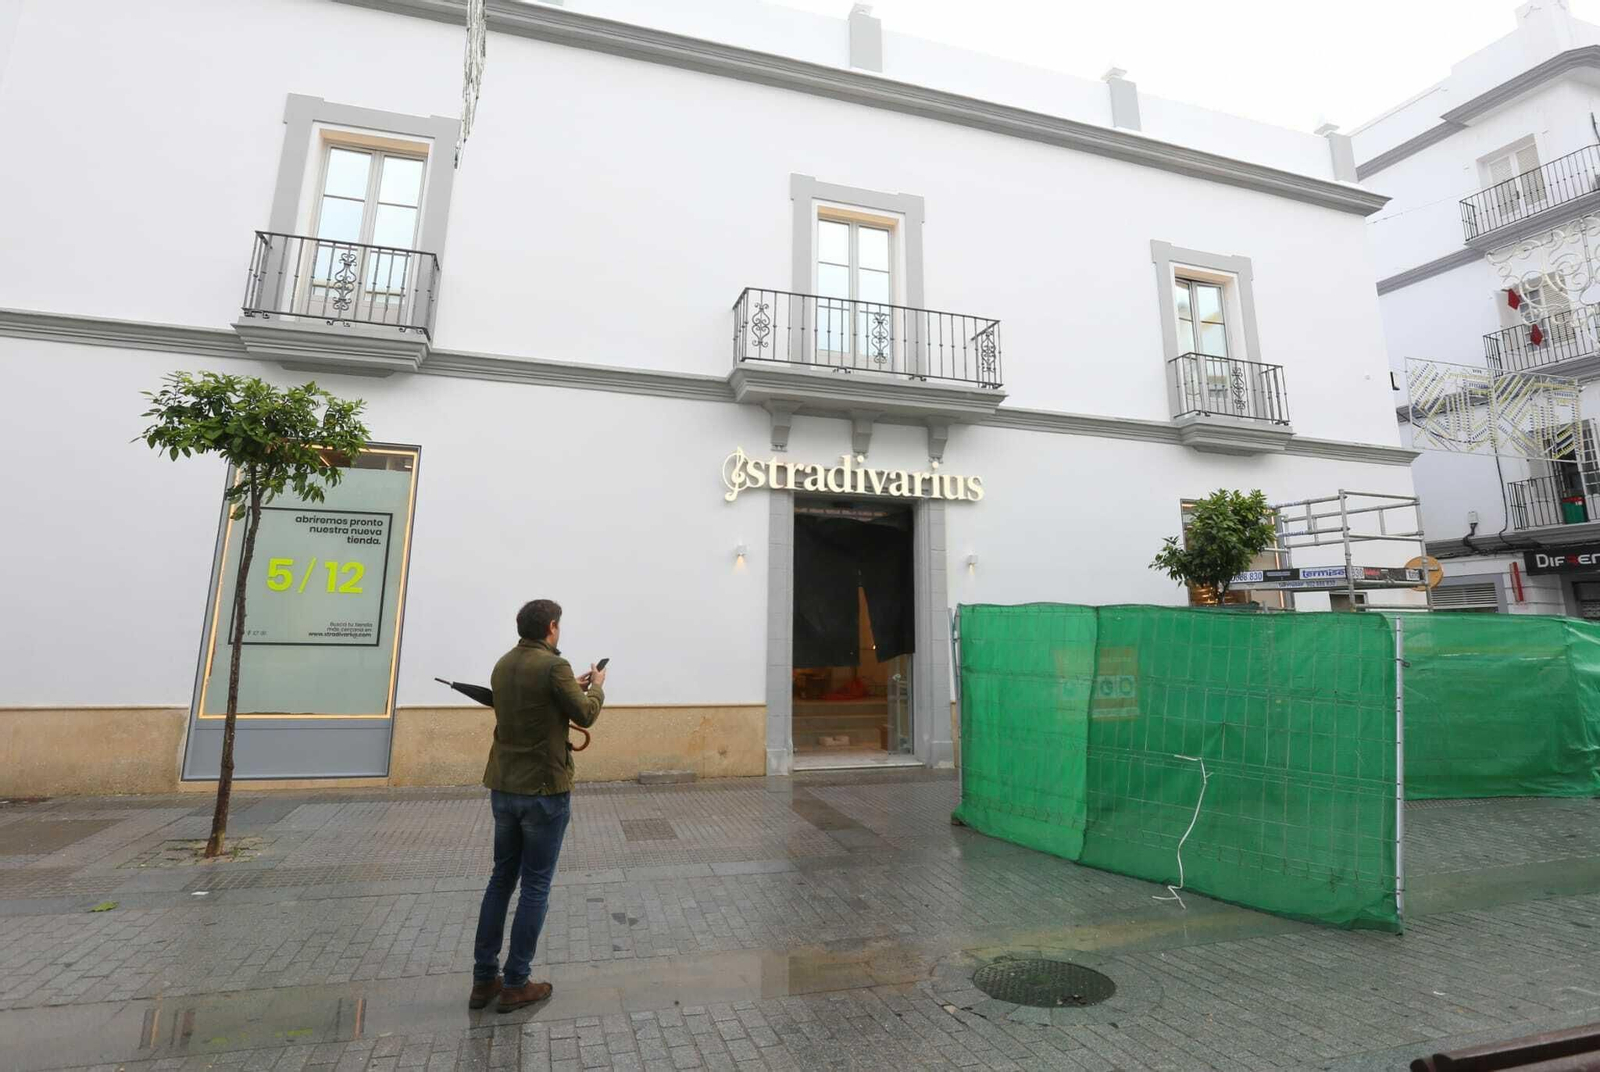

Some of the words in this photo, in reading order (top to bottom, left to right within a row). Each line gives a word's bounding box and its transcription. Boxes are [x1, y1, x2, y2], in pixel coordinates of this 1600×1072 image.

[746, 454, 985, 502] stradivarius
[295, 515, 348, 526] abriremos
[349, 518, 384, 528] pronto
[309, 525, 349, 535] nuestra
[350, 528, 382, 536] nueva
[347, 535, 381, 545] tienda.
